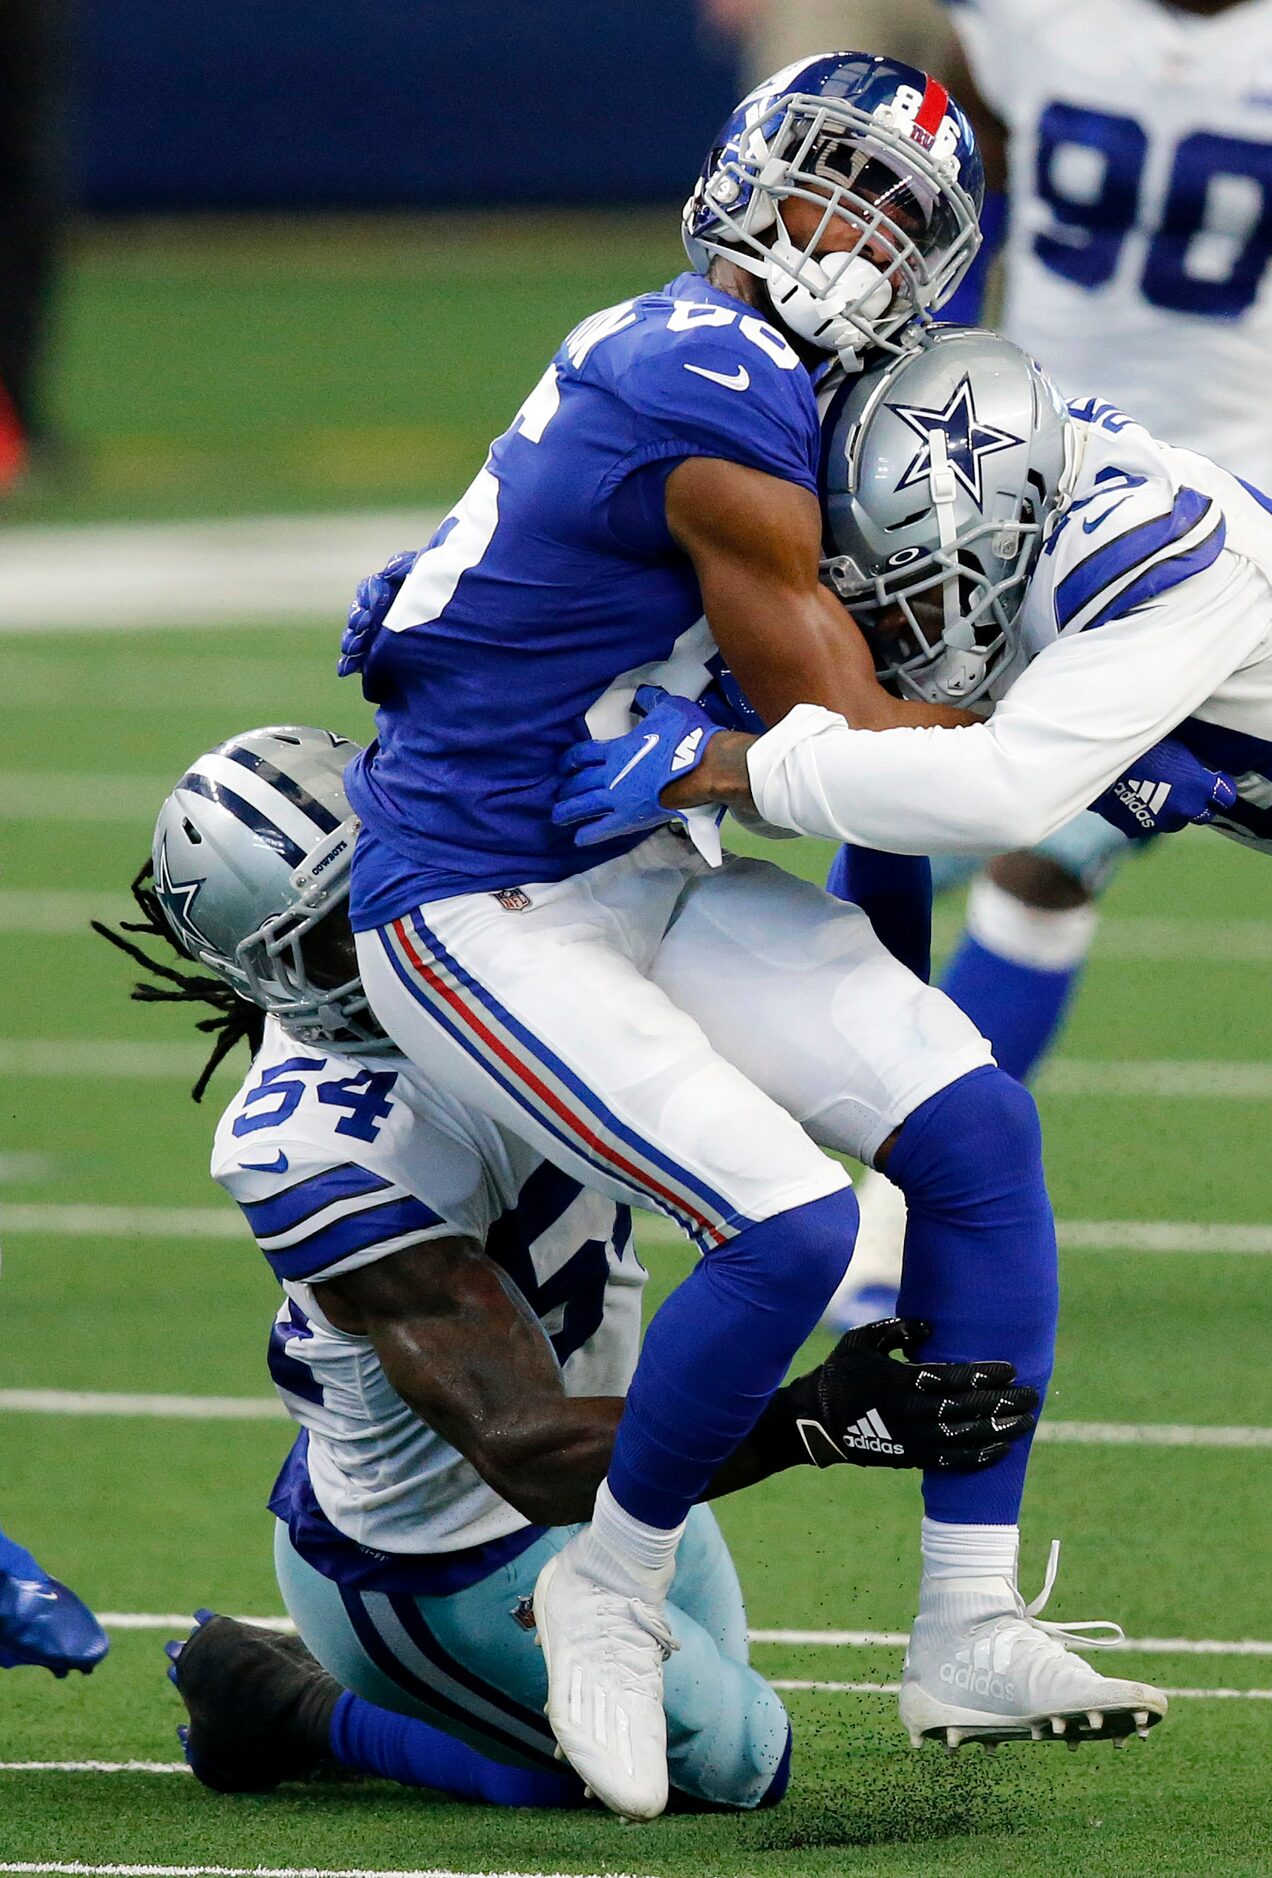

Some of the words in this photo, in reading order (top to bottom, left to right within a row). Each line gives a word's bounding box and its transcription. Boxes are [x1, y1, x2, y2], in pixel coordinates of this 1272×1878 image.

[1114, 782, 1155, 828] adidas
[312, 840, 348, 876] COWBOYS
[232, 1056, 399, 1143] 54
[842, 1433, 905, 1455] adidas
[939, 1662, 1016, 1703] adidas
